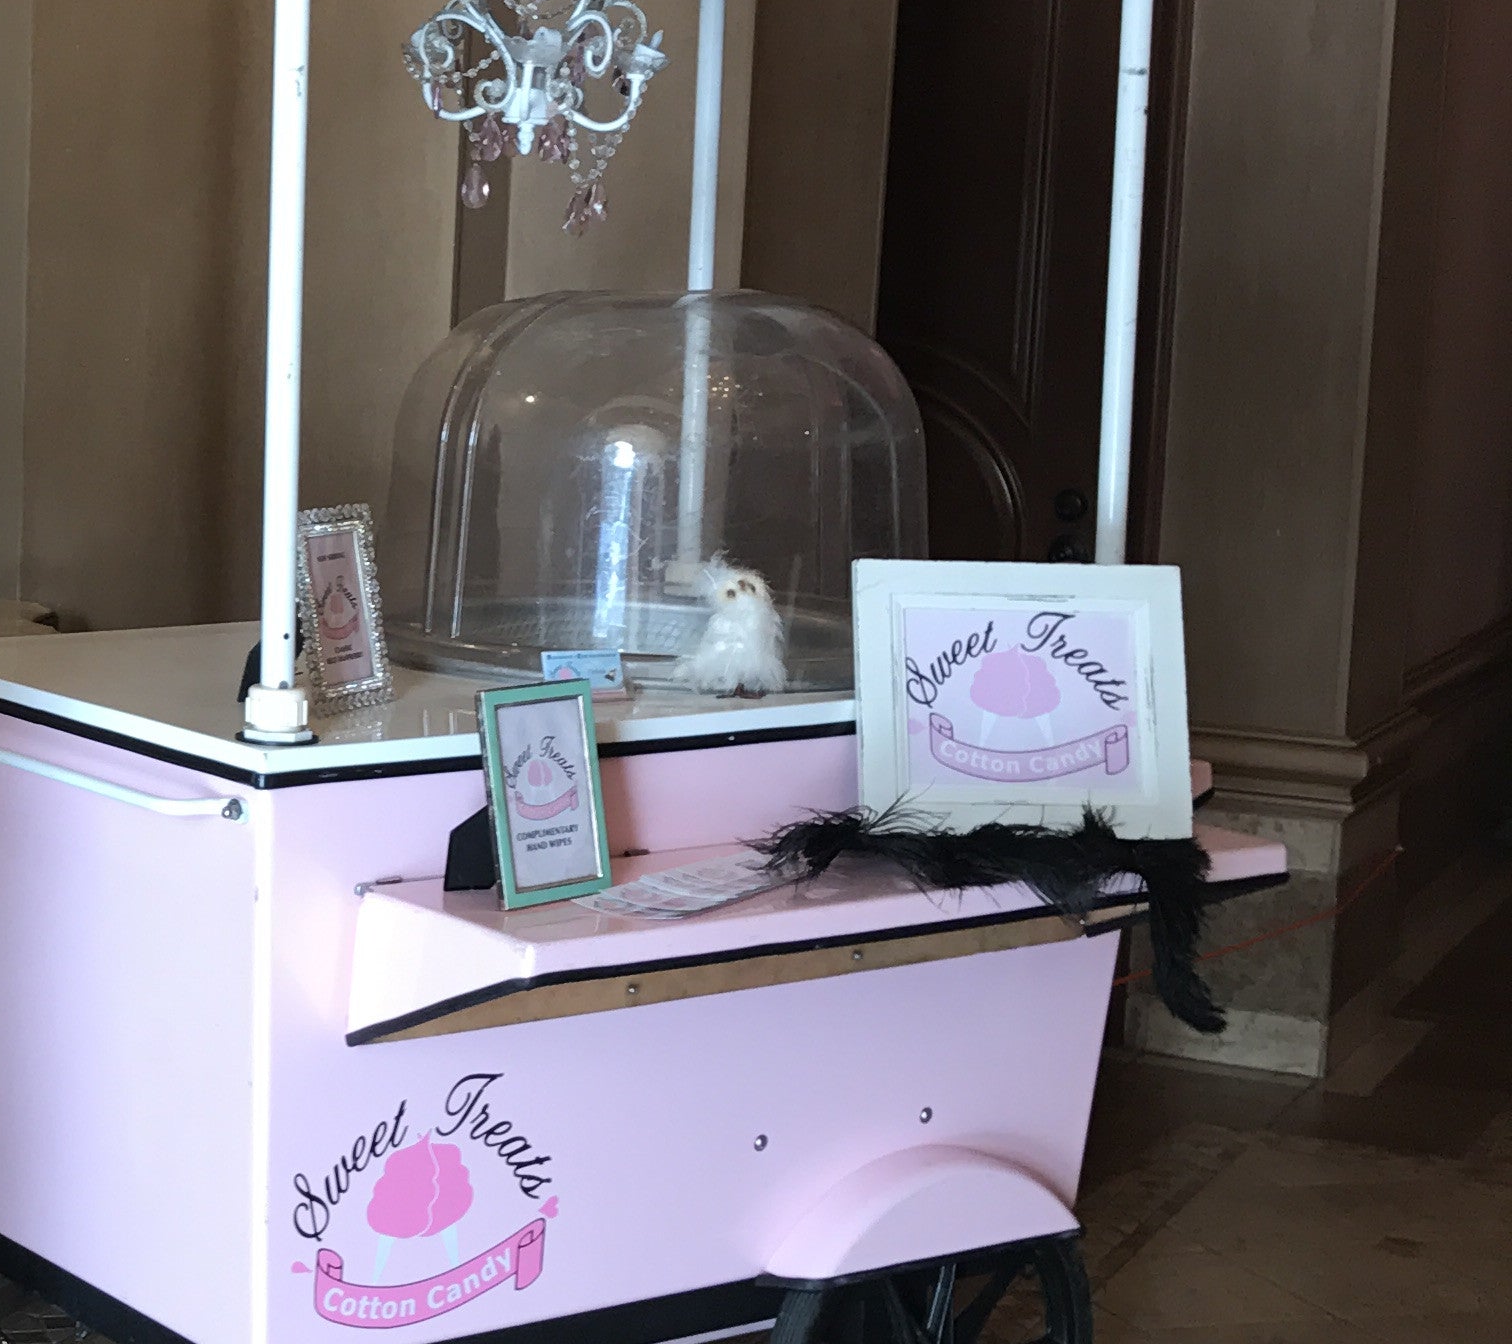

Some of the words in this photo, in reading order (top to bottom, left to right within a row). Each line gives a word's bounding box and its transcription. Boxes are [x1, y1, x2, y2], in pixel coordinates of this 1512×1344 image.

[906, 620, 998, 709] Sweet
[1020, 611, 1129, 711] Treats
[540, 735, 576, 780] Treats
[939, 740, 1021, 775] Cotton
[1028, 741, 1102, 774] Candy
[293, 1099, 409, 1242] Sweet
[435, 1072, 553, 1199] Treats
[323, 1287, 416, 1320] Cotton
[427, 1249, 514, 1310] Candy
